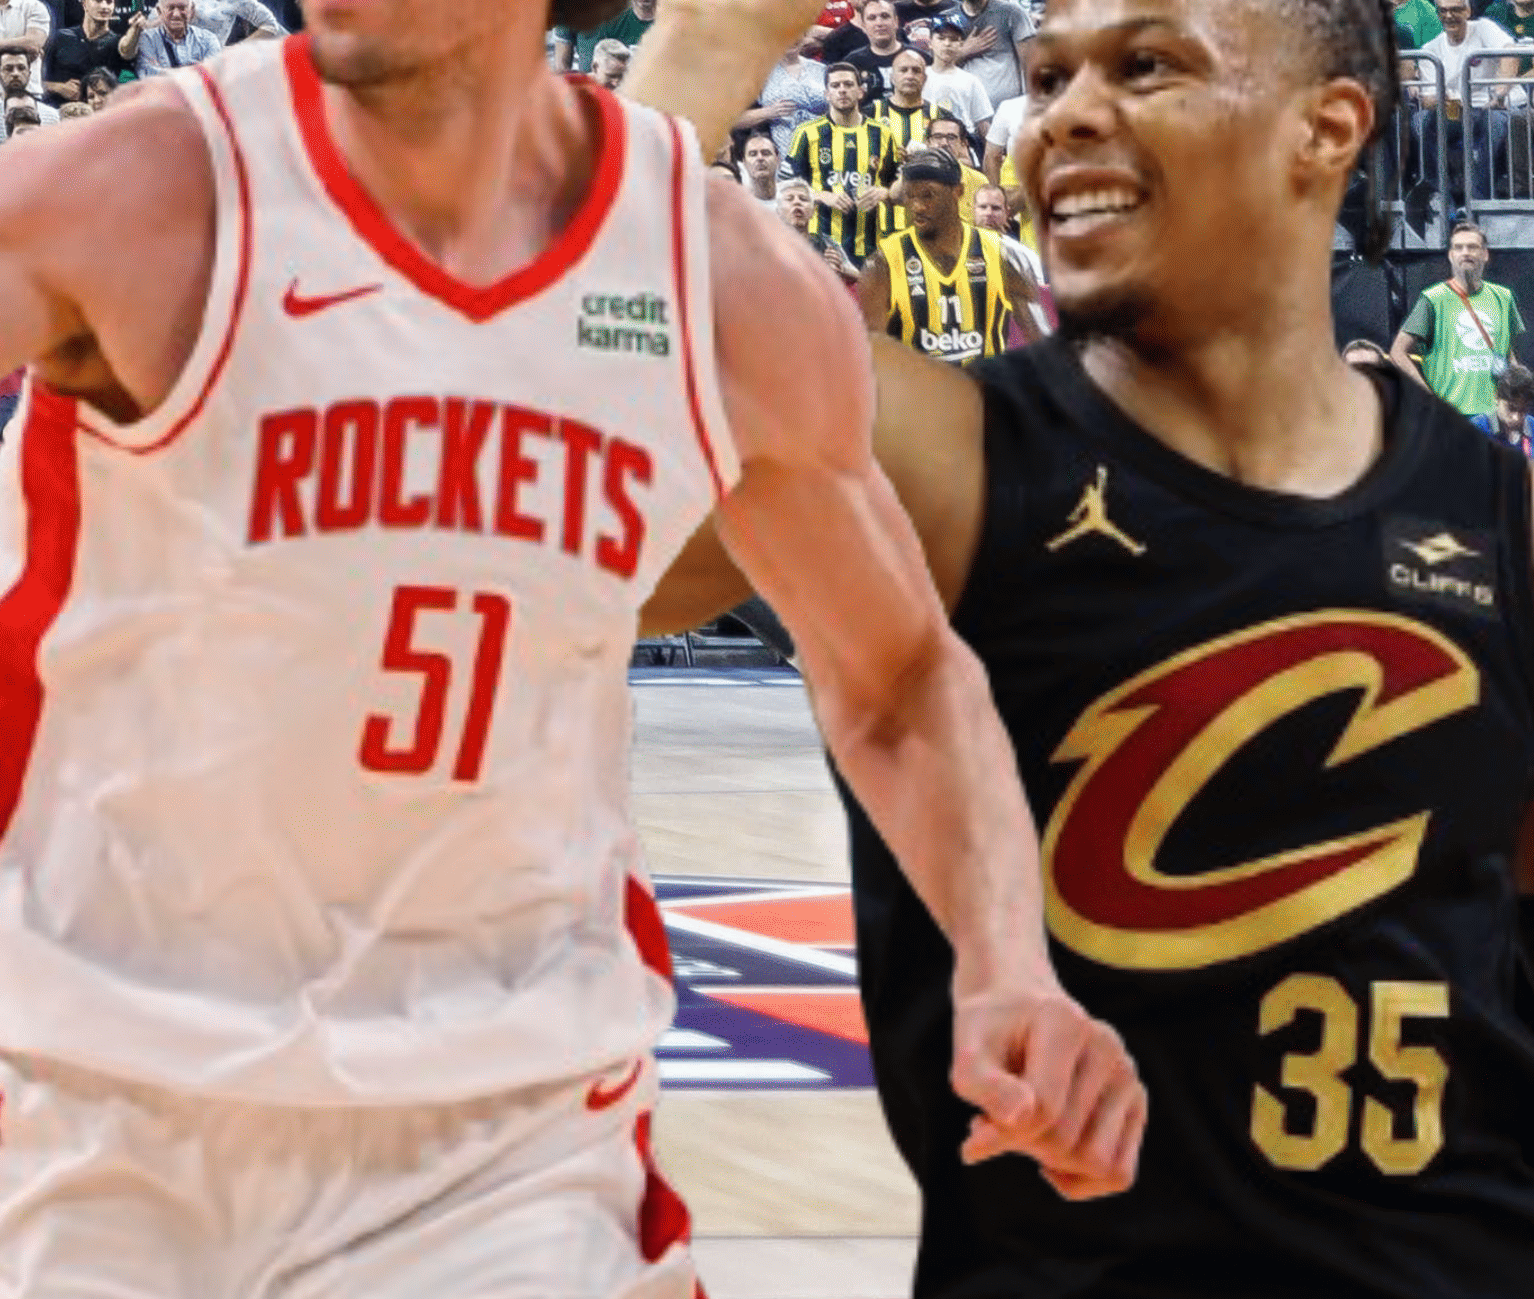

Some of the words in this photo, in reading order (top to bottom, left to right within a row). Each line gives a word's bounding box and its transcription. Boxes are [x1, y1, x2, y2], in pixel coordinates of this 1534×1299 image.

[827, 169, 872, 188] avea
[581, 293, 670, 326] credit
[938, 295, 963, 324] 11
[577, 317, 671, 357] karma
[920, 328, 983, 352] beko
[245, 395, 656, 580] ROCKETS
[357, 584, 512, 782] 51
[1250, 972, 1451, 1176] 35
